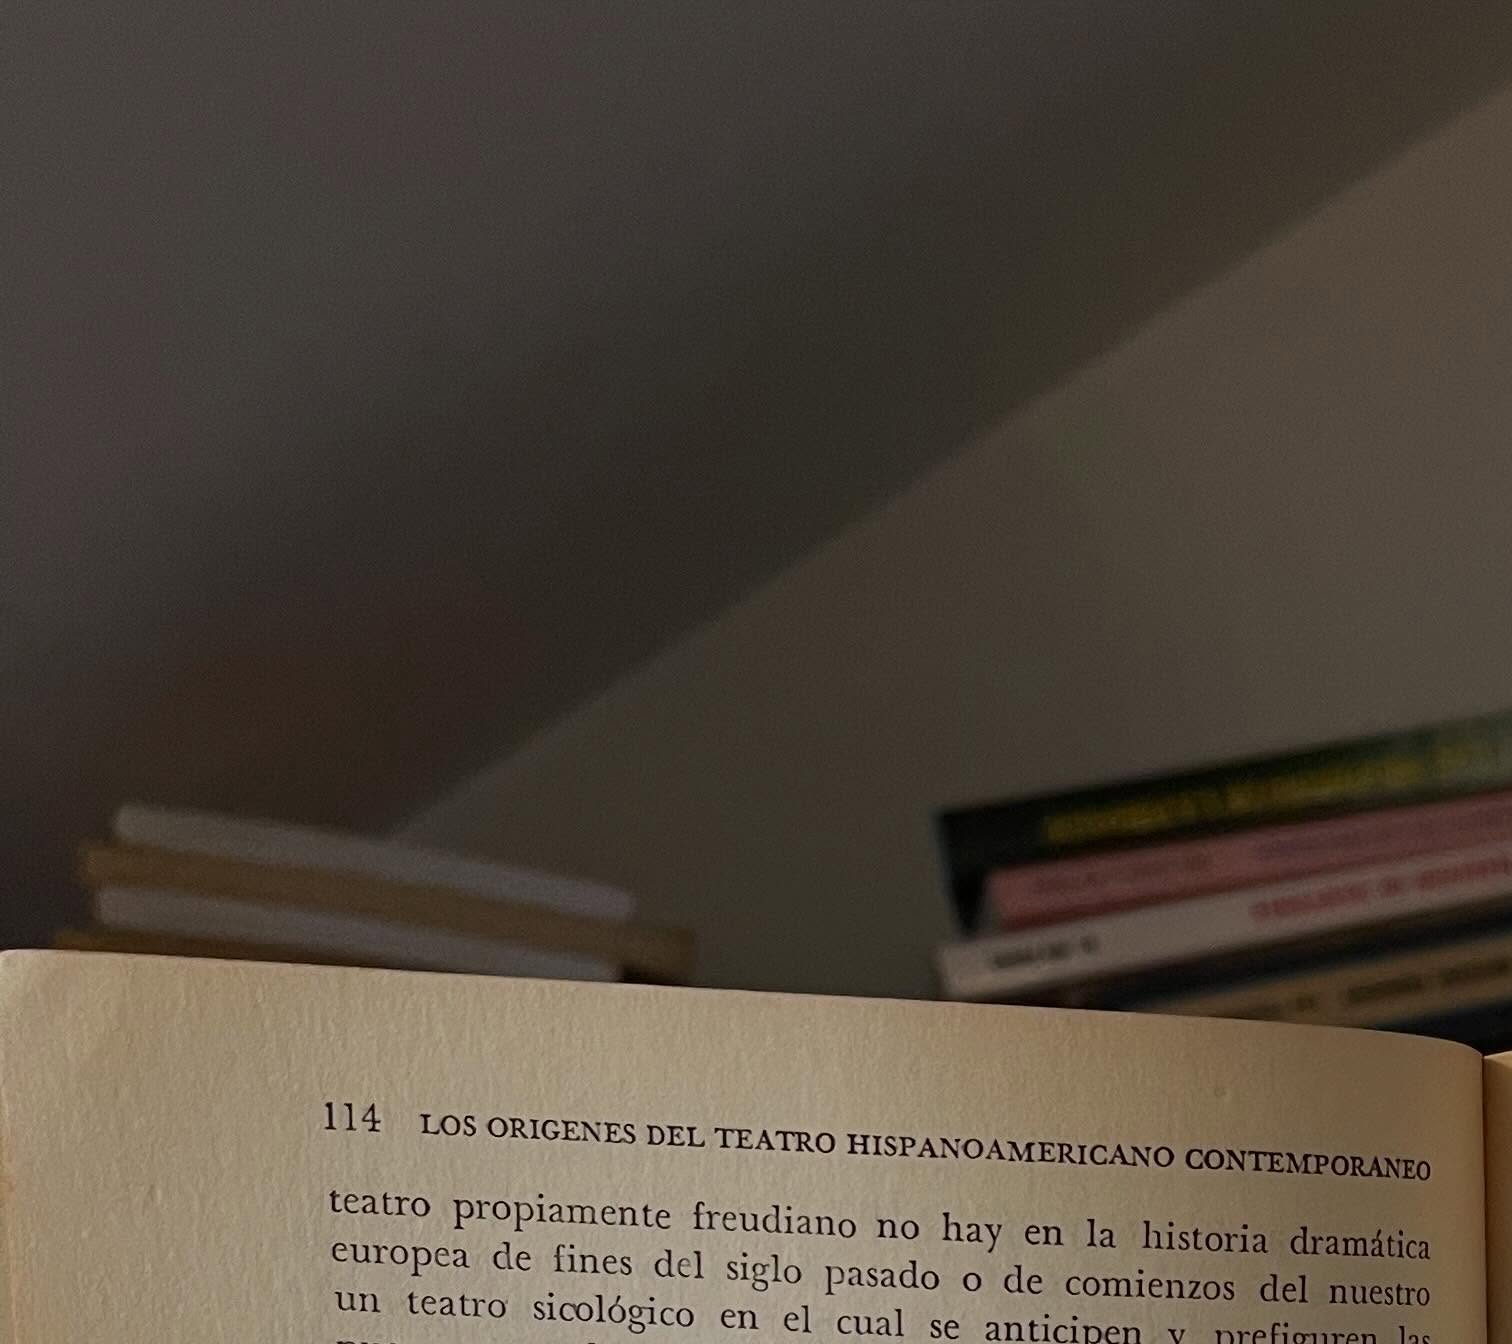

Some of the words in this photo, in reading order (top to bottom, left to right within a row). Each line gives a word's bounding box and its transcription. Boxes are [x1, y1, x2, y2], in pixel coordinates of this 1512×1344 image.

[323, 1101, 382, 1133] 114
[418, 1113, 477, 1138] LOS
[485, 1116, 637, 1145] ORIGENES
[646, 1124, 706, 1148] DEL
[713, 1127, 836, 1154] TEATRO
[846, 1132, 1176, 1168] HISPANOAMERICANO
[1184, 1148, 1431, 1182] CONTEMPORANEO
[328, 1189, 432, 1218] teatro
[452, 1192, 672, 1233] propiamente
[692, 1200, 857, 1239] freudiano
[875, 1218, 920, 1241] no
[941, 1211, 1003, 1254] hay
[1024, 1224, 1065, 1246] en
[1086, 1218, 1117, 1249] la
[1141, 1219, 1269, 1254] historia
[1289, 1225, 1431, 1261] dramática
